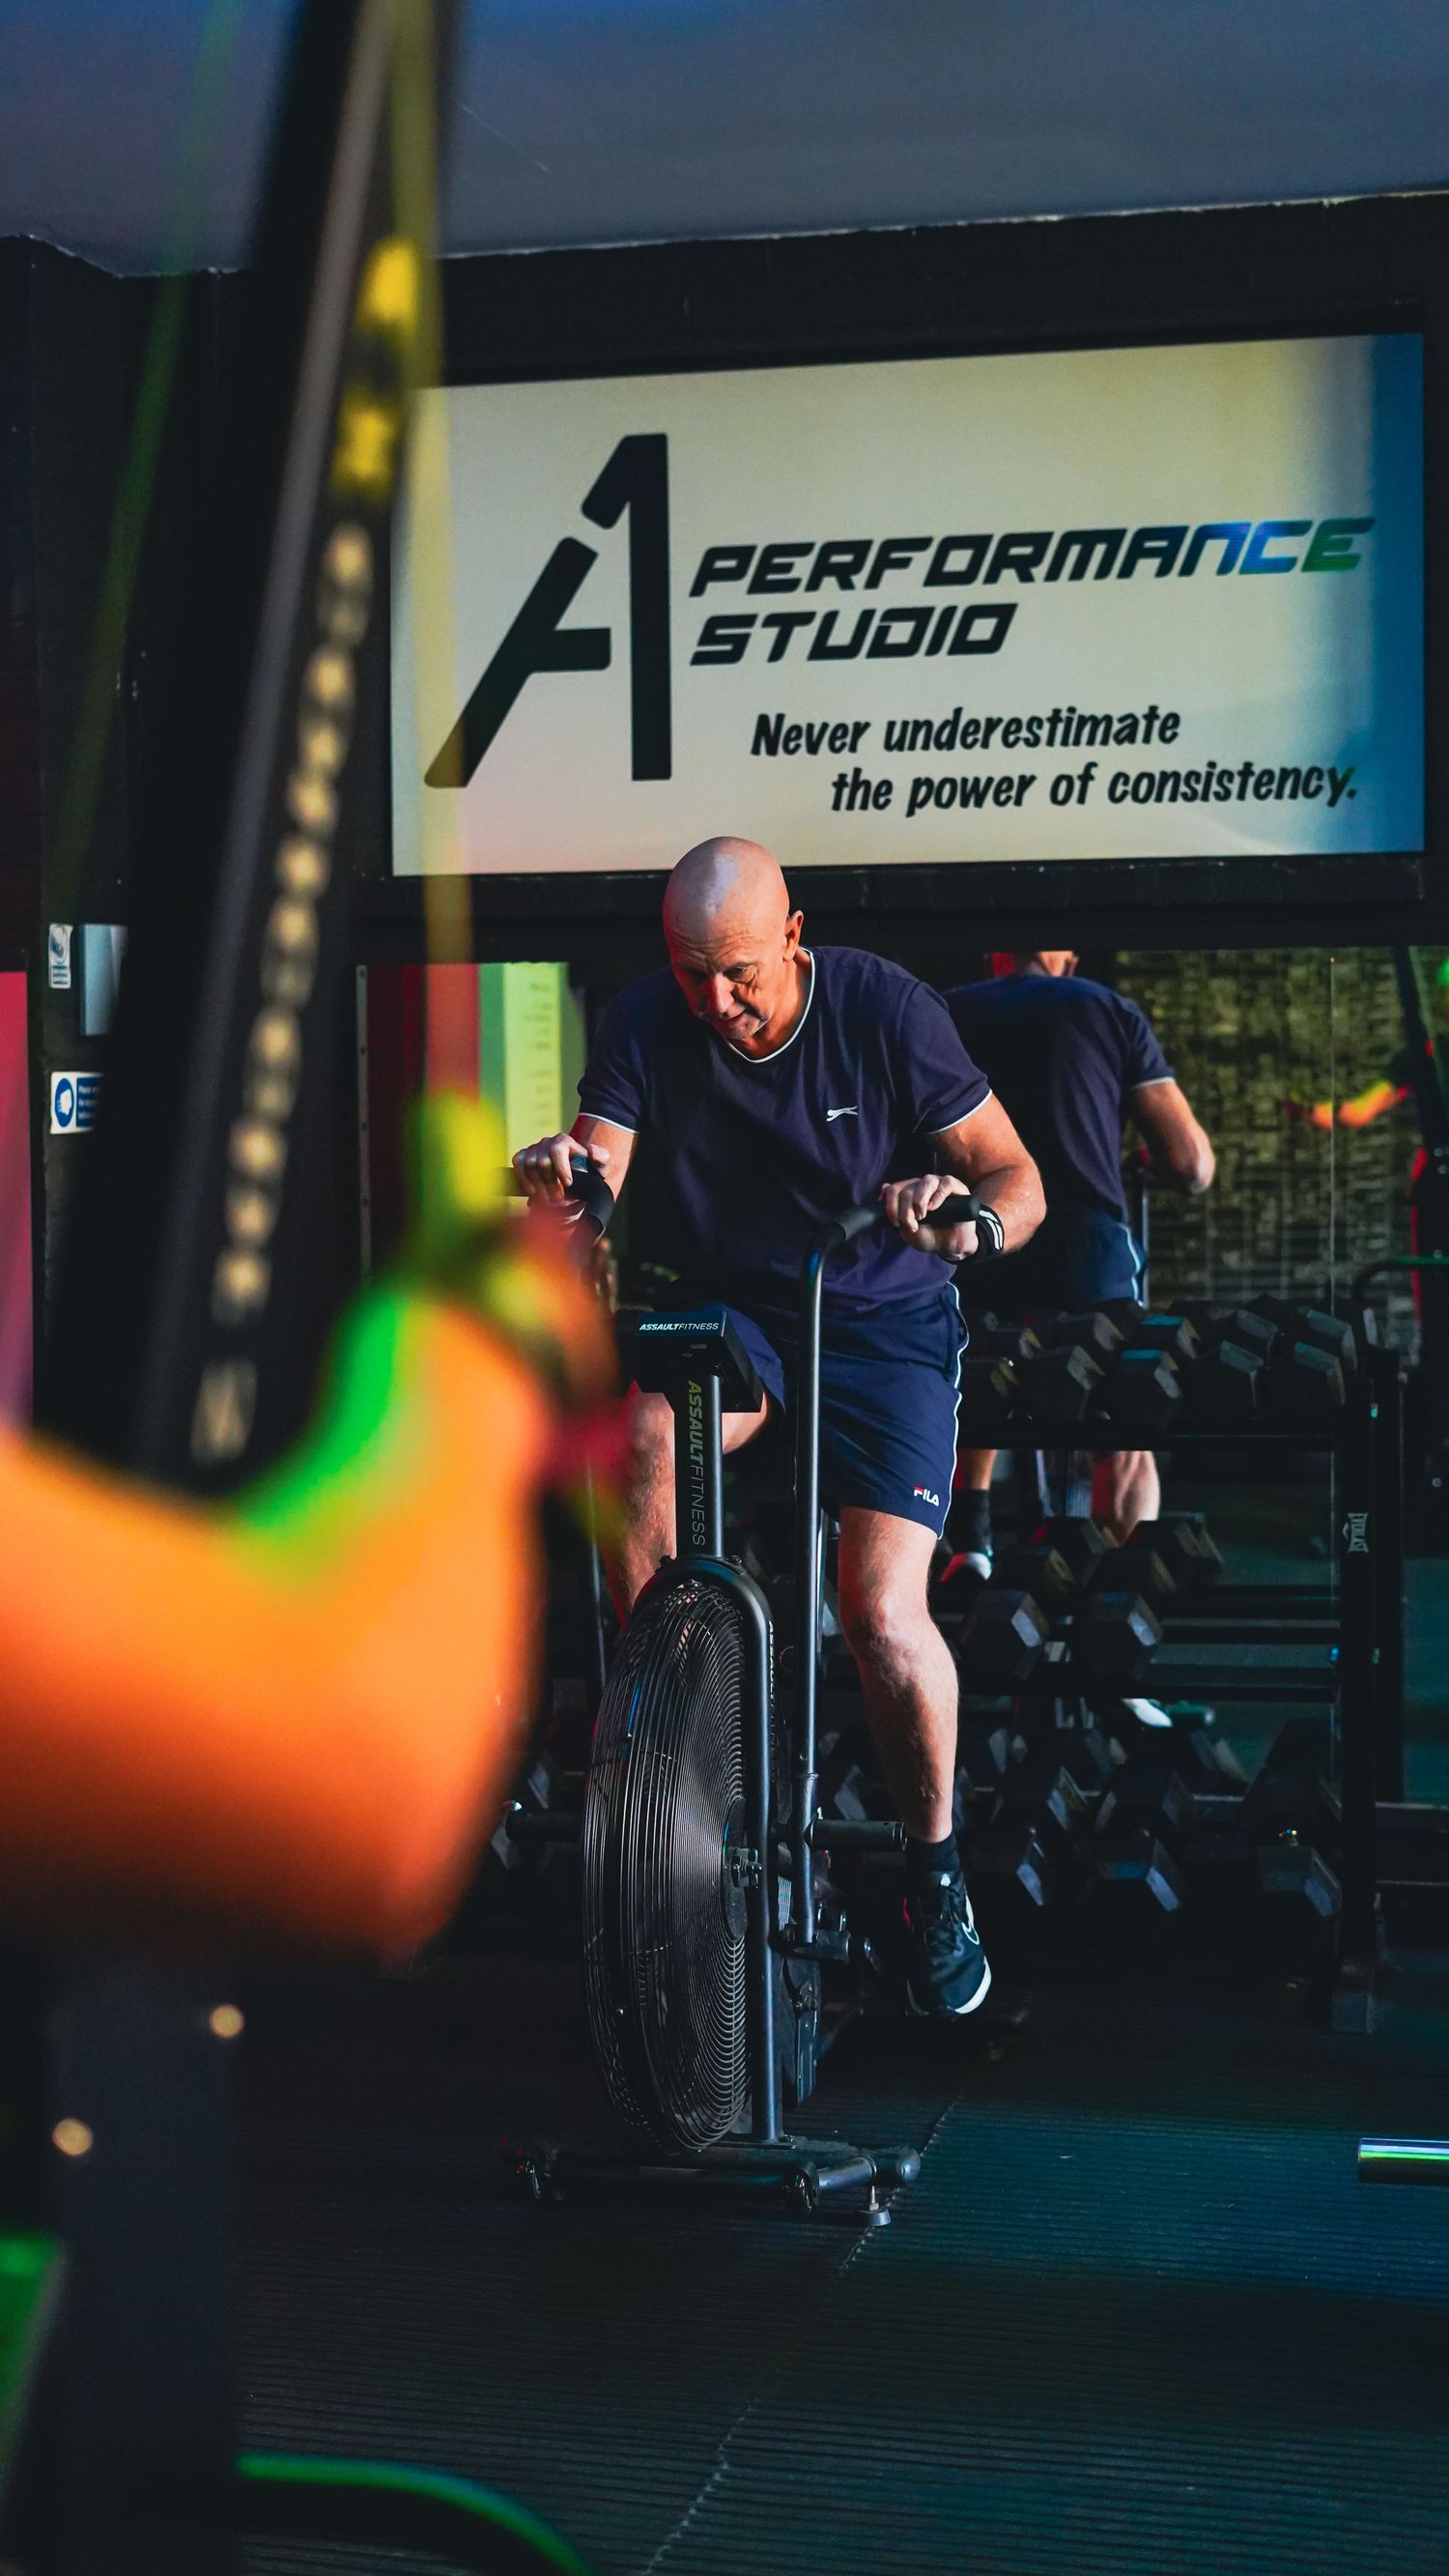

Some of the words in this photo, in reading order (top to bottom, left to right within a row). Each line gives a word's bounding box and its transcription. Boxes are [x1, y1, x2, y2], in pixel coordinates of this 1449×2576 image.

[689, 518, 1375, 598] PERFORMANCE
[690, 602, 1019, 667] STUDIO
[750, 705, 871, 758] Never
[883, 703, 1182, 753] underestimate
[831, 766, 894, 813] the
[904, 771, 1037, 819] power
[1048, 760, 1098, 809] of
[1107, 758, 1360, 809] consistency.
[639, 1322, 719, 1331] ASSAULTFITNESS
[688, 1380, 705, 1546] ASSAULTFITNESS
[913, 1485, 940, 1507] FILA
